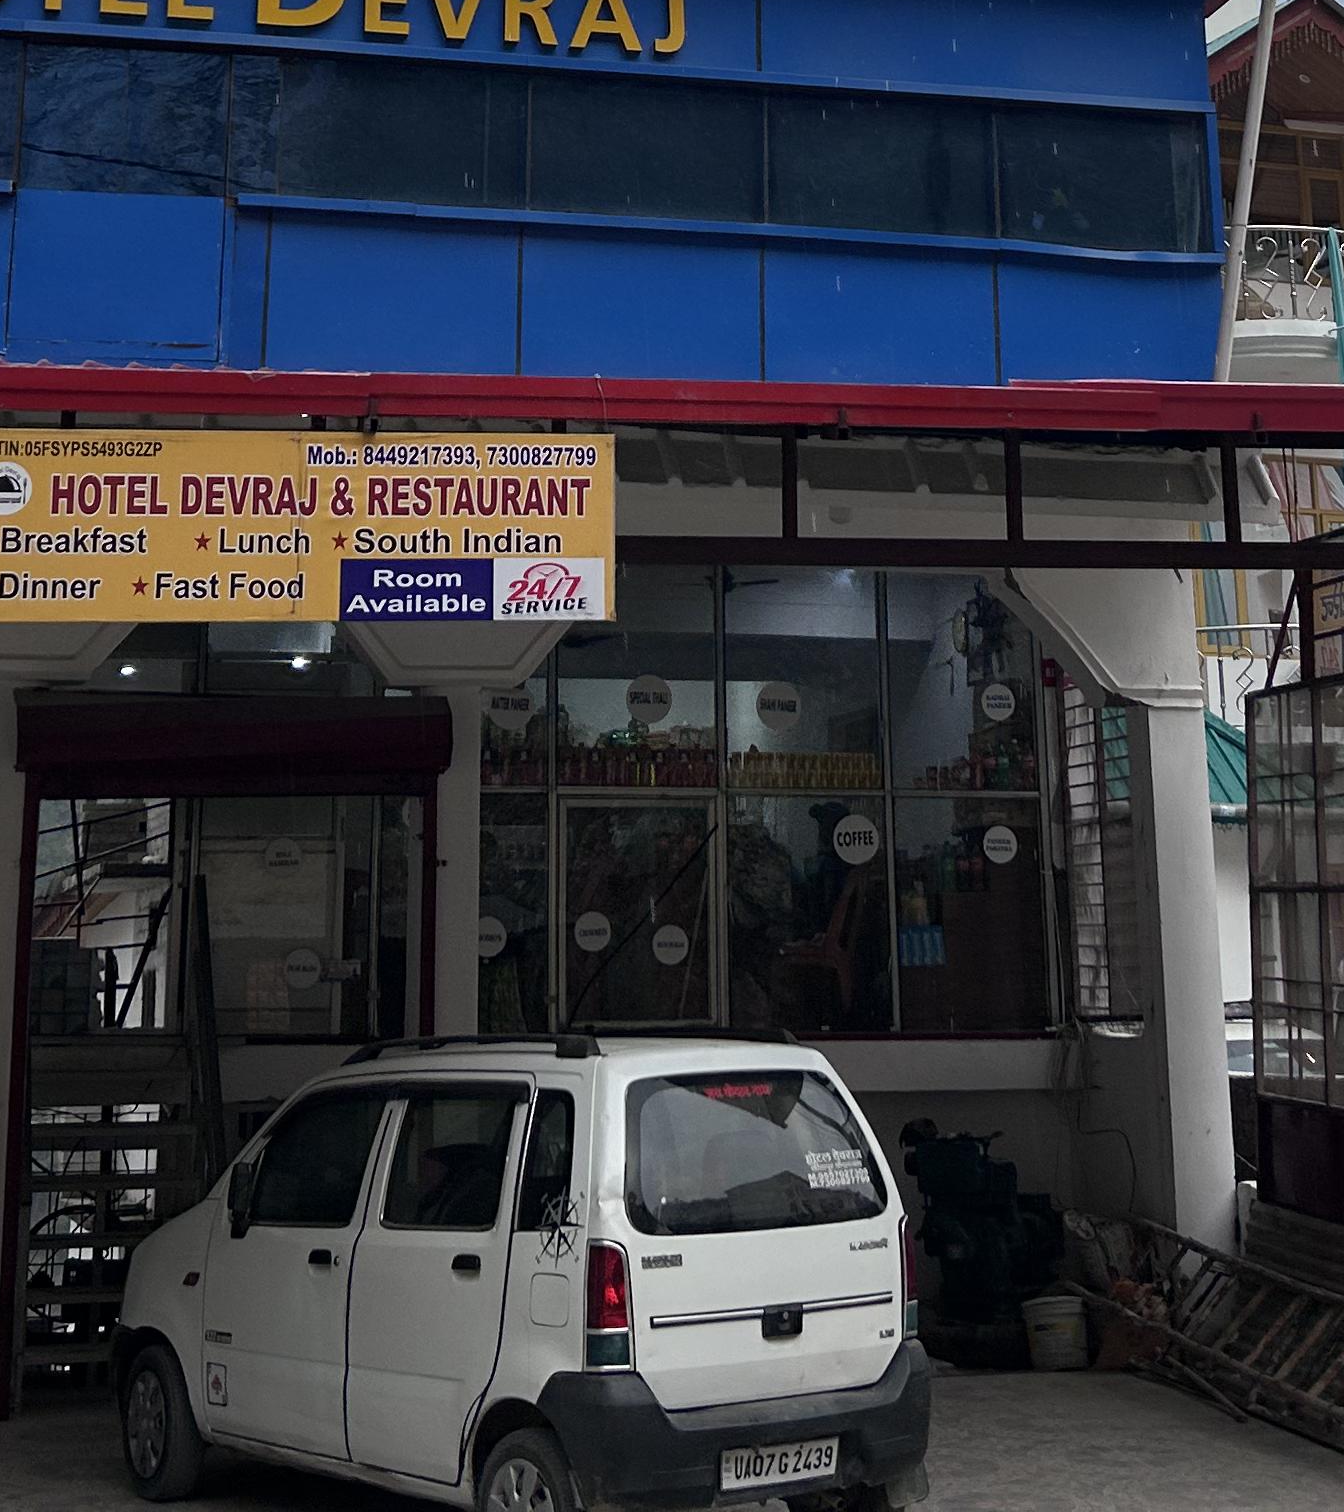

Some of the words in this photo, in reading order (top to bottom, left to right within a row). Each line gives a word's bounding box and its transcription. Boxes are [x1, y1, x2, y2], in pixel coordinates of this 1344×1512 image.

[307, 445, 358, 466] Mob.:
[363, 445, 482, 469] 8449217393,
[486, 446, 597, 467] 7300827799
[50, 474, 169, 516] HOTEL
[180, 475, 318, 517] DEVRAJ
[330, 476, 355, 517] &
[366, 476, 592, 517] RESTAURANT
[0, 526, 148, 556] Breakfast
[218, 527, 312, 555] Lunch
[353, 527, 454, 555] South
[462, 527, 563, 555] Indian
[154, 572, 221, 600] Fast
[230, 572, 305, 600] Food
[372, 568, 463, 590] Room
[506, 574, 582, 601] 24/7
[346, 593, 487, 615] Available
[500, 596, 589, 615] SERVICE
[837, 830, 874, 846] COFFEE
